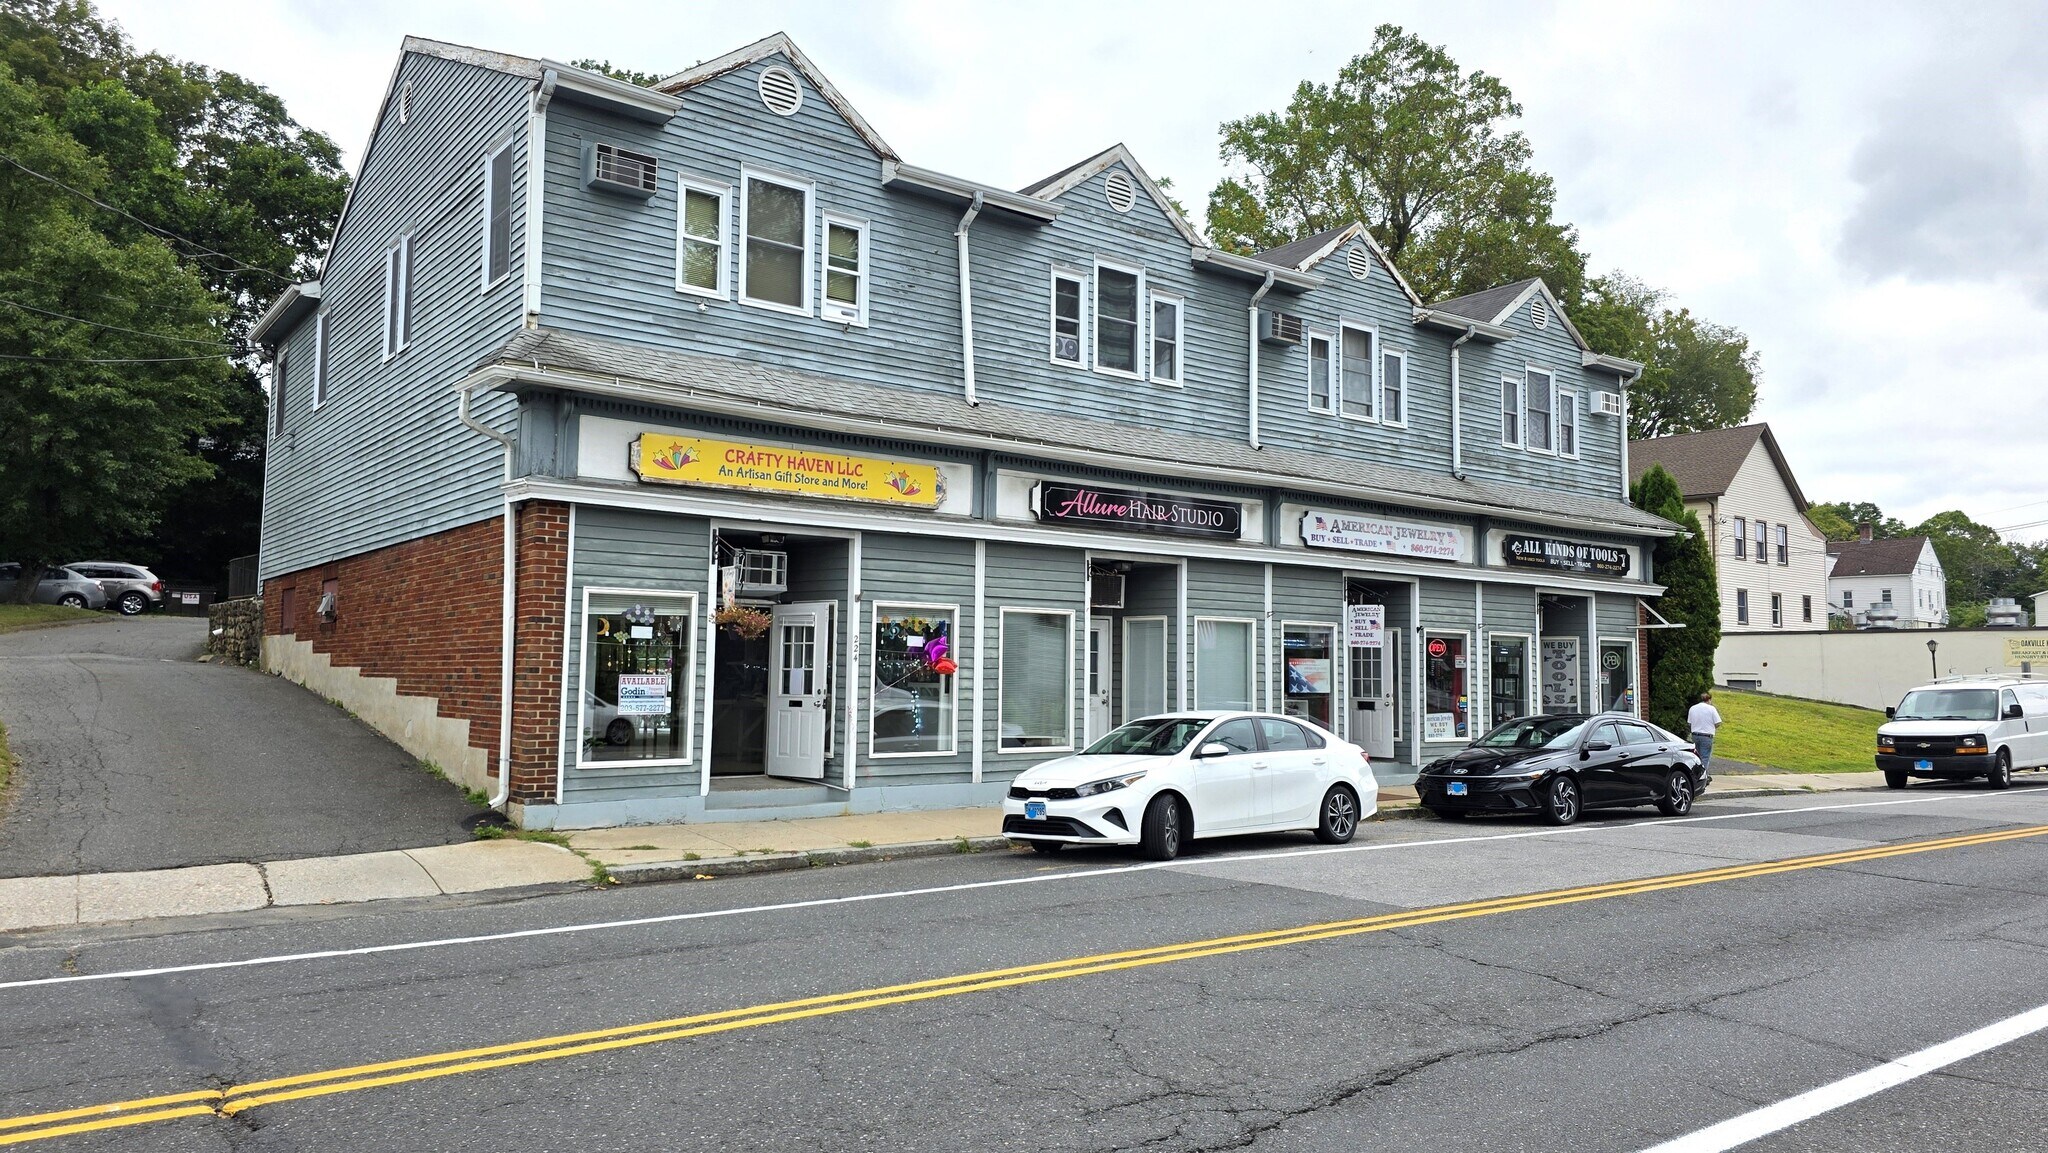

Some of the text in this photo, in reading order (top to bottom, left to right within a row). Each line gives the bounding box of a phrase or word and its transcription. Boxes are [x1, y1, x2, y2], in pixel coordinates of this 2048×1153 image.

[724, 449, 863, 477] CRAFTY HAVEN LLC
[718, 465, 868, 490] An Artisan Gift Store and More!
[1055, 489, 1224, 527] Allure HAIR STUDIO
[1330, 519, 1446, 545] AMERICAN JEWELRY
[1311, 534, 1455, 556] BUY SELL TRADE 860-274-2274
[1523, 540, 1618, 562] ALL KINDS OF TOOLS
[1430, 644, 1444, 652] OPEN
[1552, 650, 1566, 704] TOOLS
[621, 687, 646, 695] Godin
